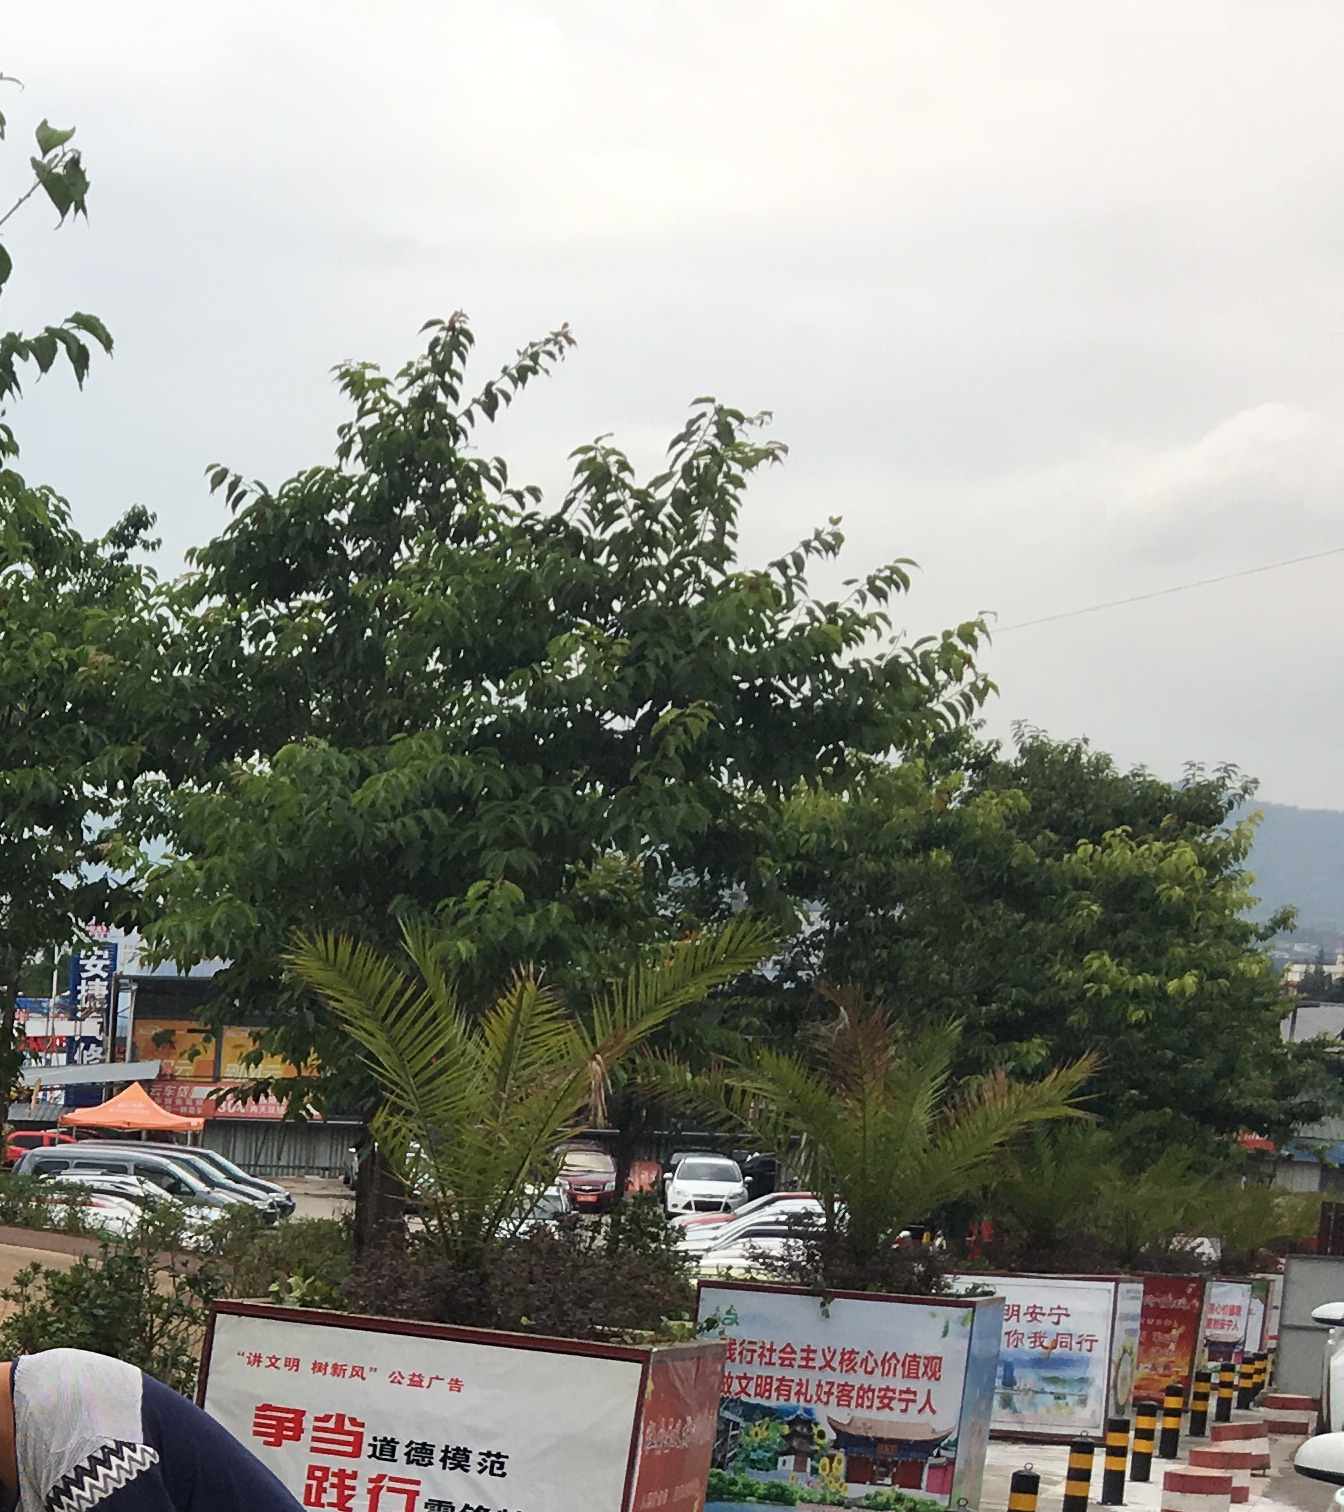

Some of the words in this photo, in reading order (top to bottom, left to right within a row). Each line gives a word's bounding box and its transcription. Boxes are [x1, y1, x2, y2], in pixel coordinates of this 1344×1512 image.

[1004, 1329, 1099, 1353] 你我同行
[388, 1369, 465, 1393] 公益广告
